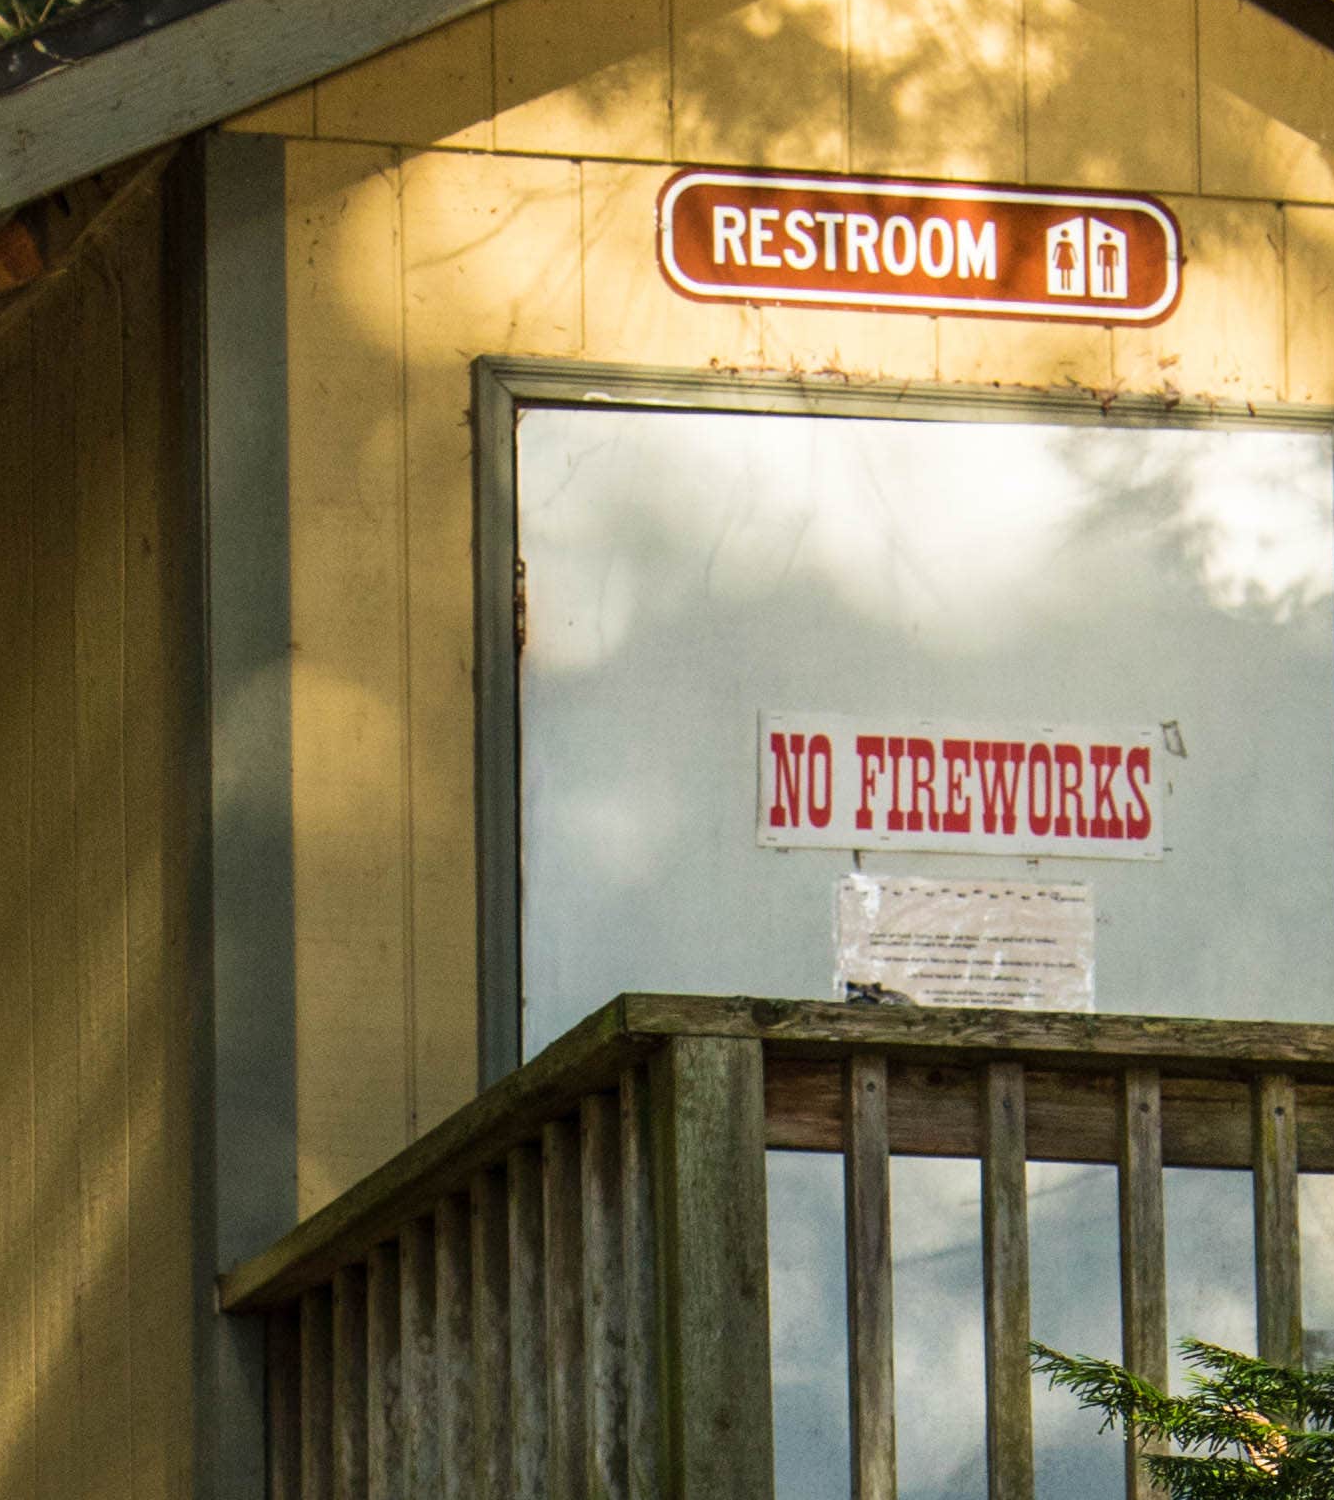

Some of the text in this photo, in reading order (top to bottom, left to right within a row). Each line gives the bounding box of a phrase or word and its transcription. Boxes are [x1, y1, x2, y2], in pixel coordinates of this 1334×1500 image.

[713, 205, 997, 280] RESTROOM
[770, 732, 1152, 840] NO FIREWORKS
